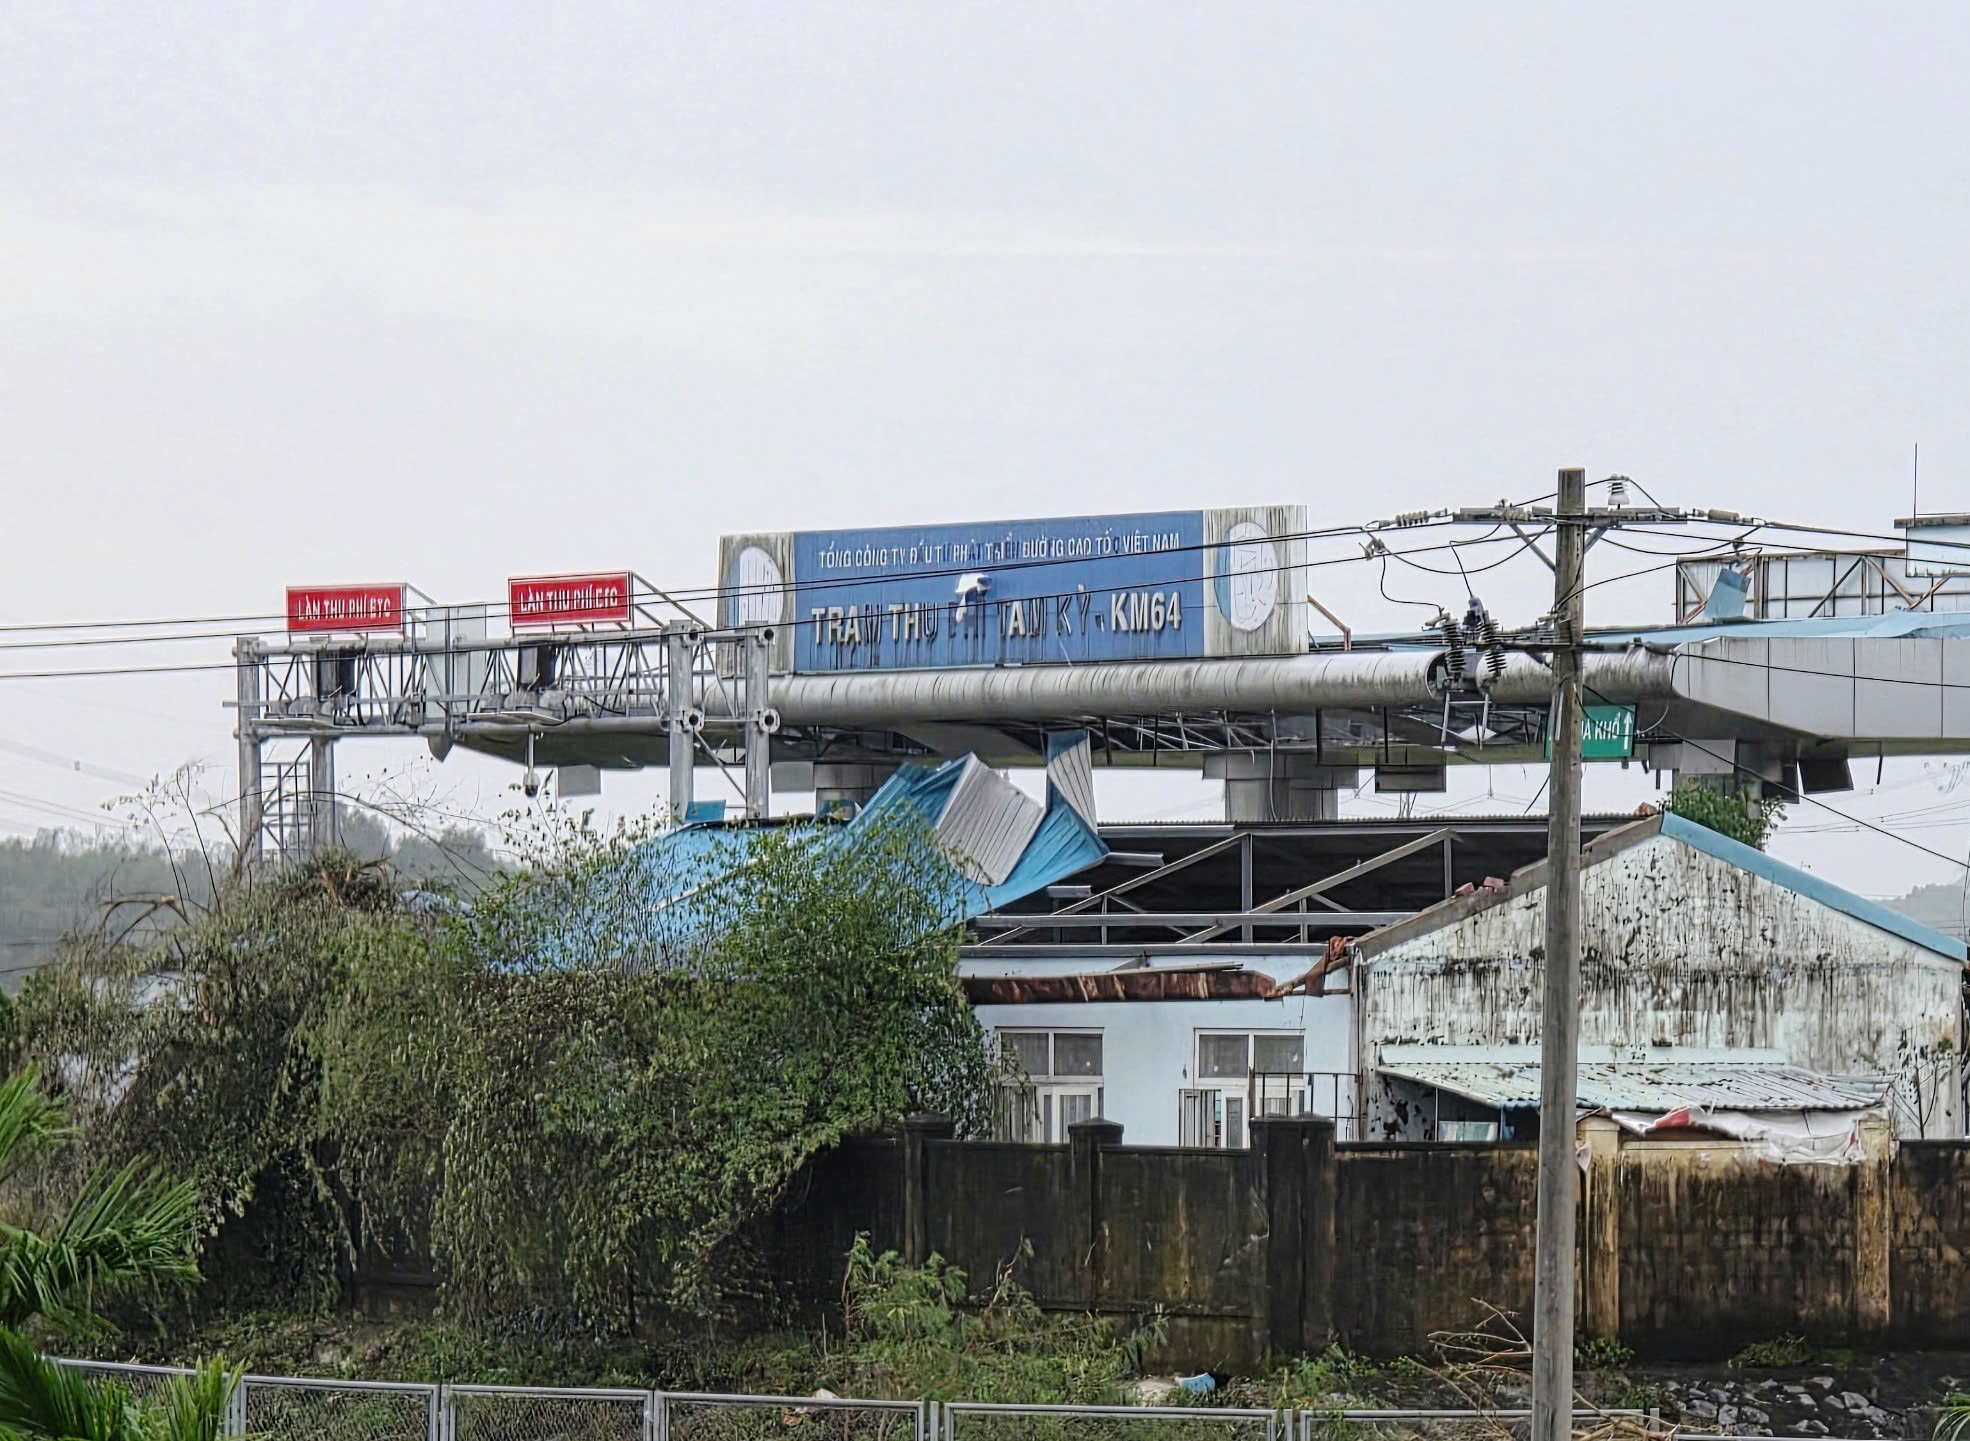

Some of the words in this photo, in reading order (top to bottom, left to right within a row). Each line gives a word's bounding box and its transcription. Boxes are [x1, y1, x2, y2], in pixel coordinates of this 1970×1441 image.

[892, 547, 905, 566] TY
[1068, 538, 1092, 556] CAO
[1152, 533, 1179, 551] NAM
[298, 594, 320, 620] LÀN
[323, 599, 345, 619] THU
[520, 586, 544, 612] LÀN
[546, 589, 570, 610] THU
[1111, 592, 1182, 633] KM64
